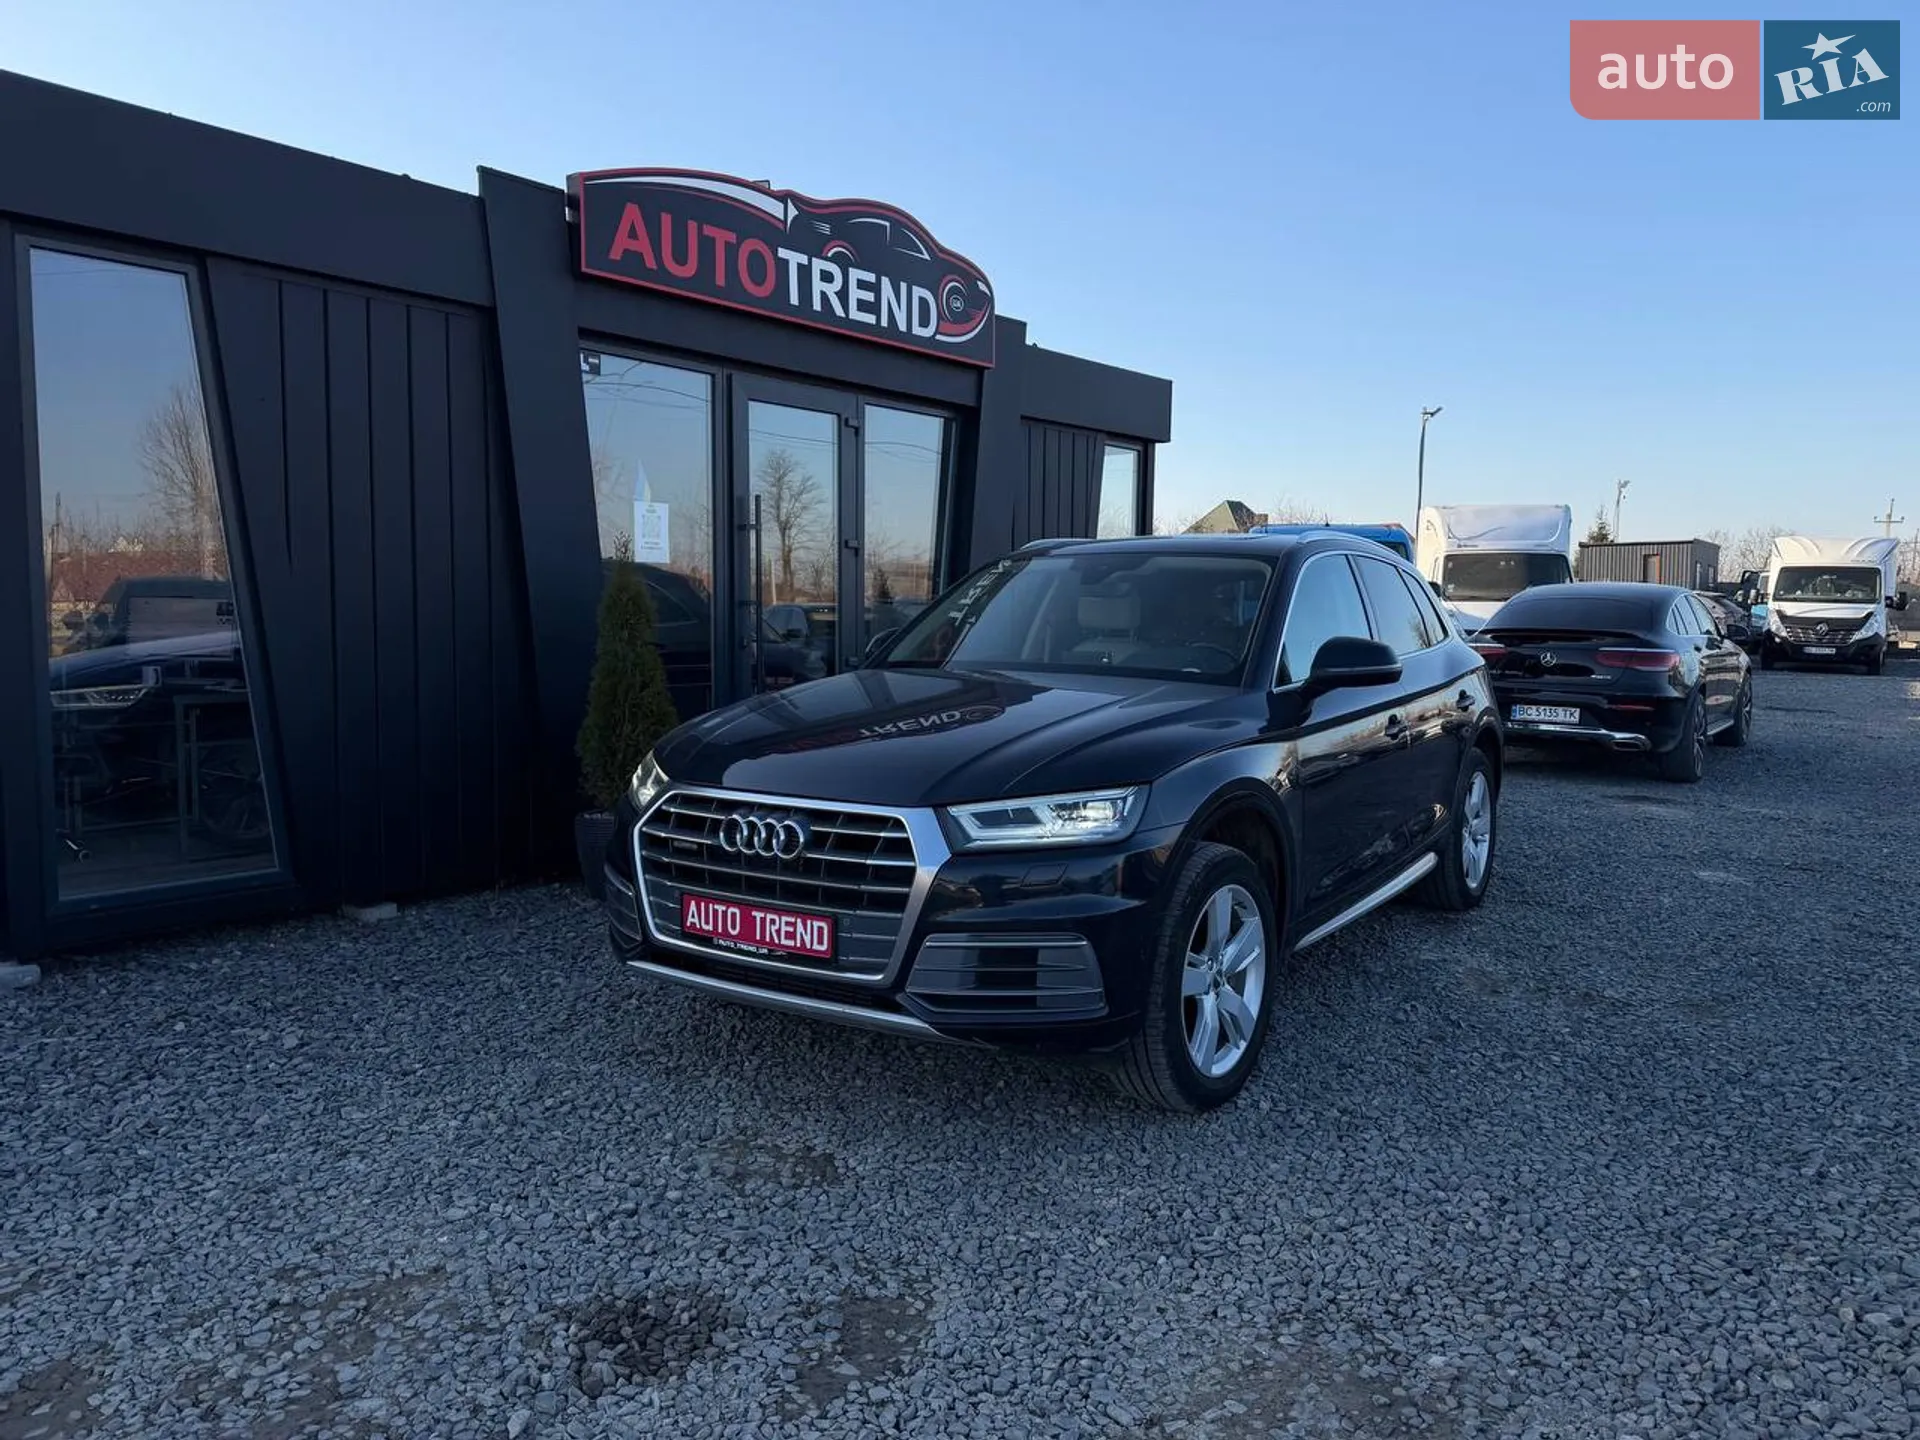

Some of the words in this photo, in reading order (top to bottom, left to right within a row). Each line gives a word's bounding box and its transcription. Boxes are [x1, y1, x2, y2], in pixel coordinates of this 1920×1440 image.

[1518, 706, 1533, 717] BC
[1535, 707, 1560, 718] 5135
[1562, 709, 1578, 720] TK
[686, 900, 741, 936] AUTO
[751, 911, 828, 951] TREND
